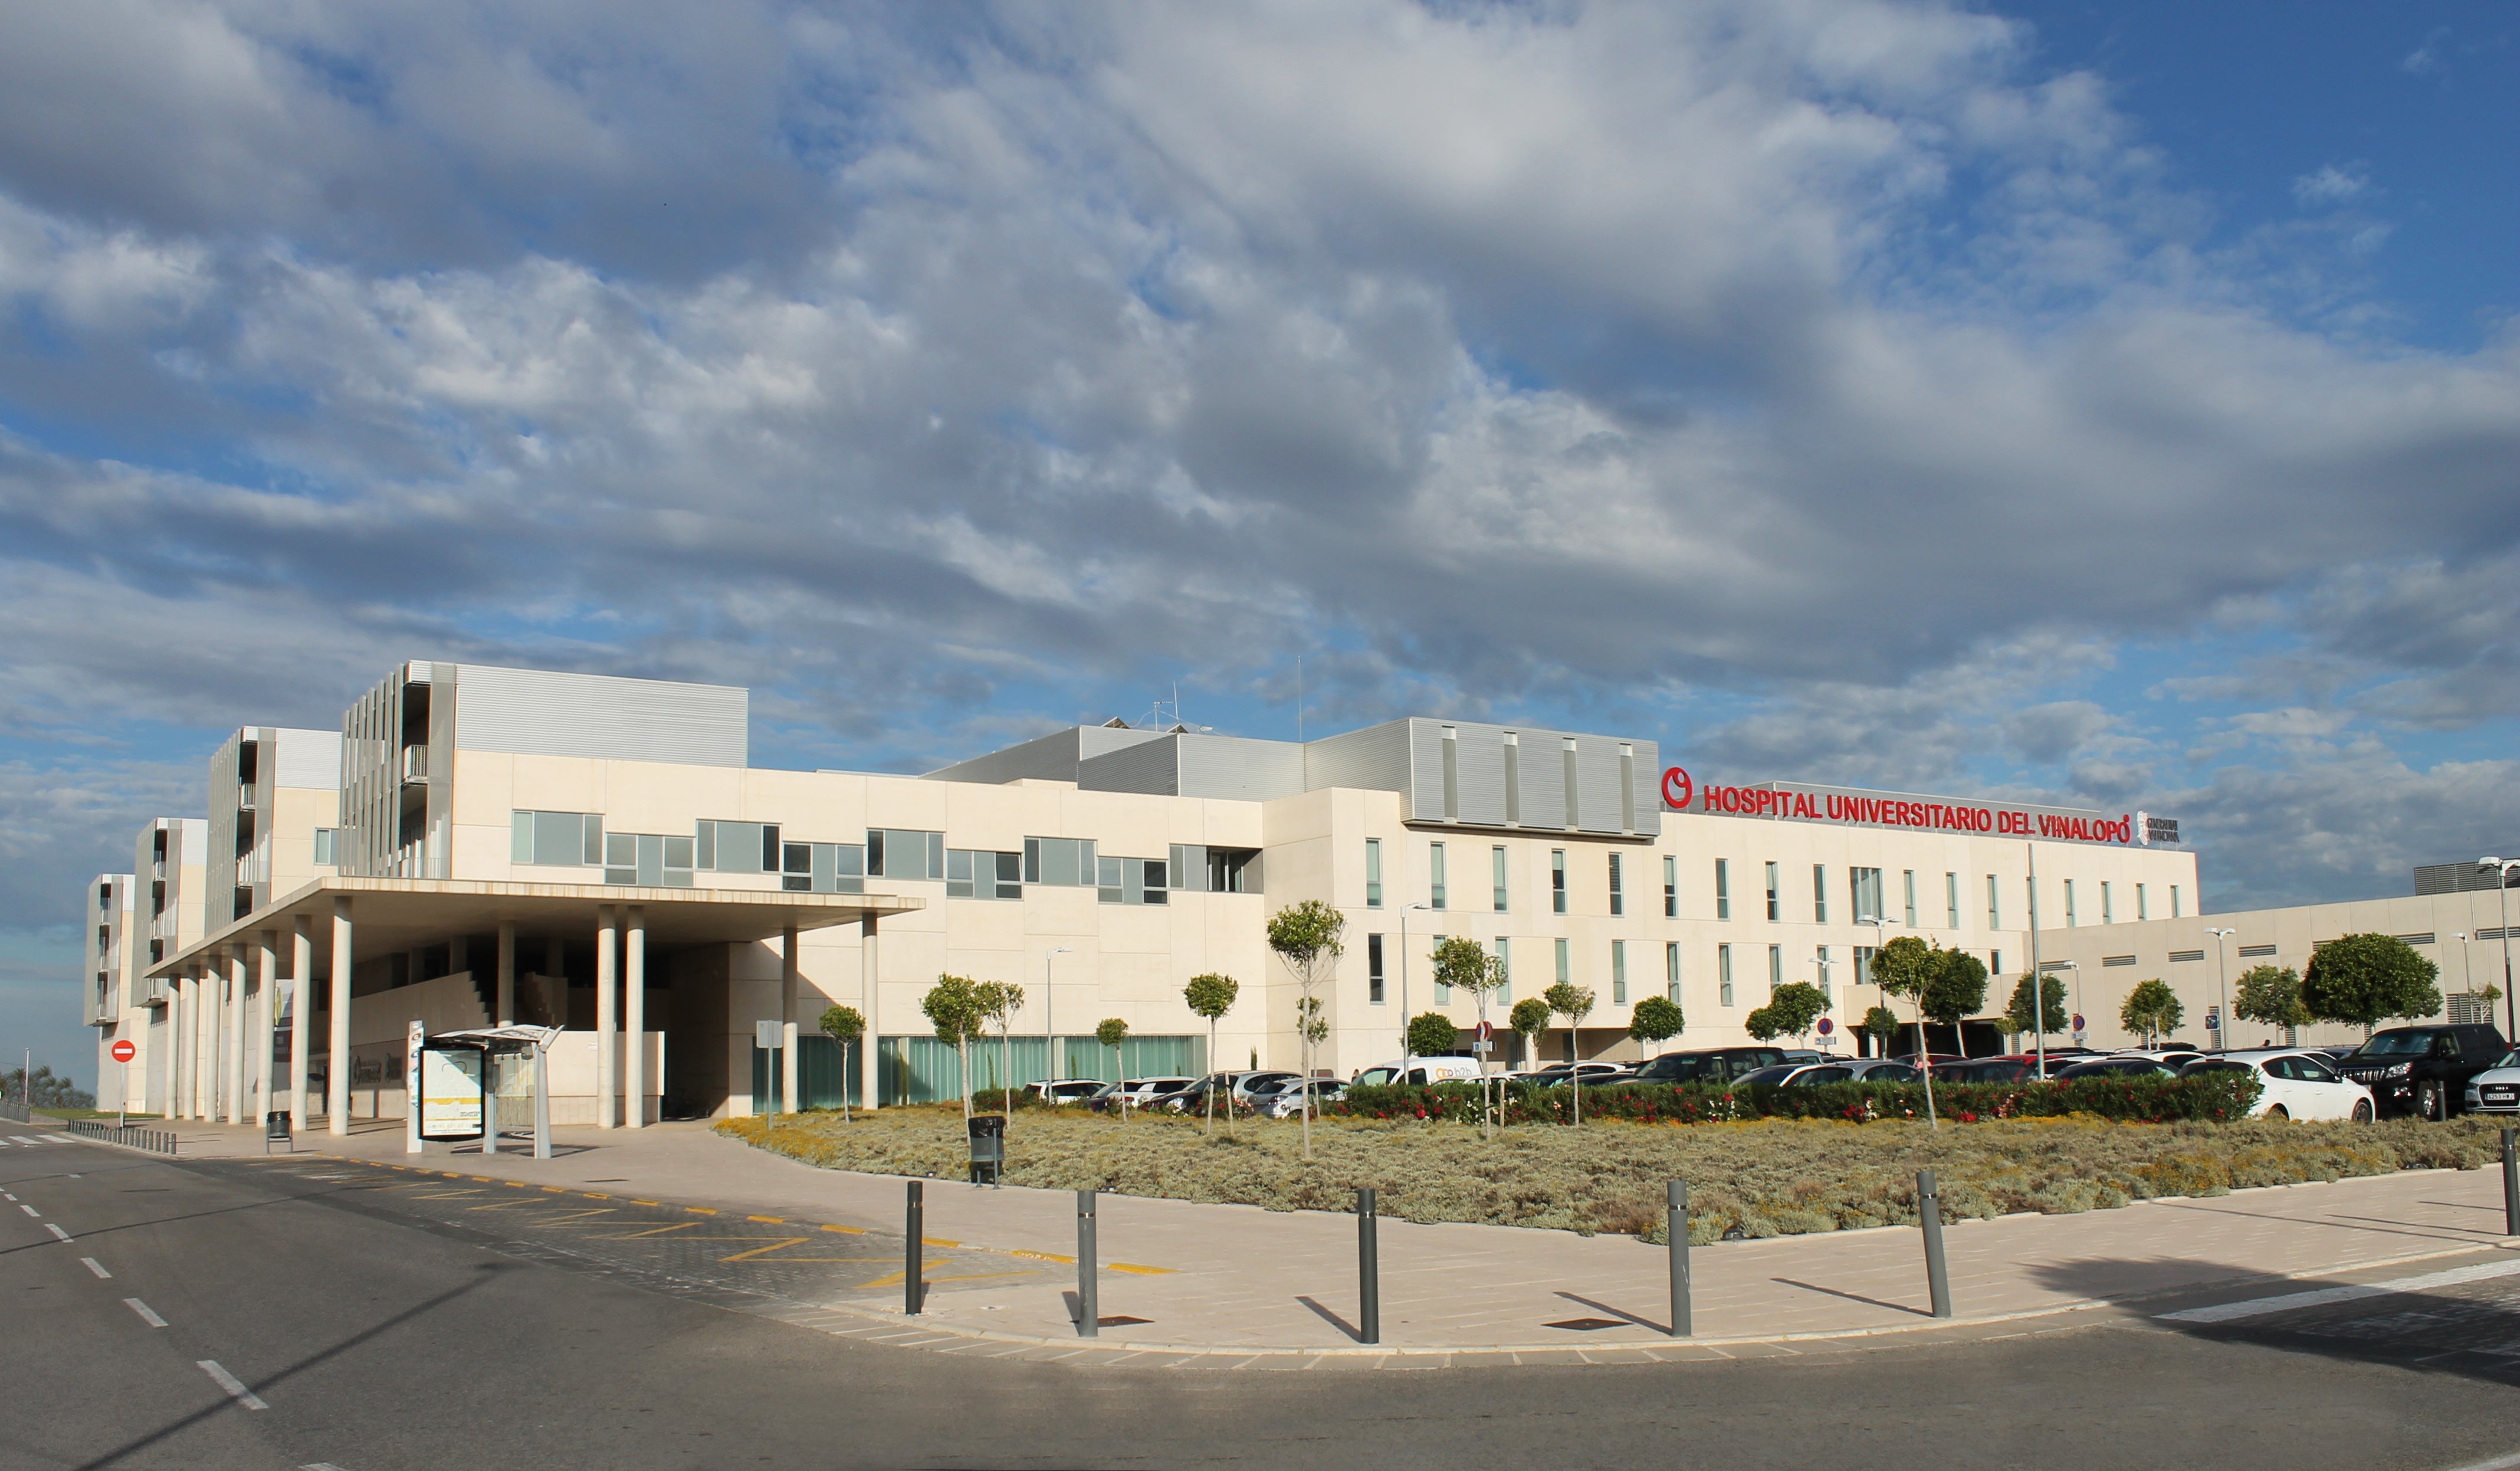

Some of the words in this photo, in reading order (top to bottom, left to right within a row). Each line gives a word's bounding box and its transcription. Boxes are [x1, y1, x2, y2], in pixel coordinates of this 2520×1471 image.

[1704, 785, 1823, 818] HOSPITAL
[1827, 794, 1993, 832] UNIVERSITARIO
[1997, 811, 2036, 835] DEL
[2038, 814, 2131, 843] VINALOPÓ
